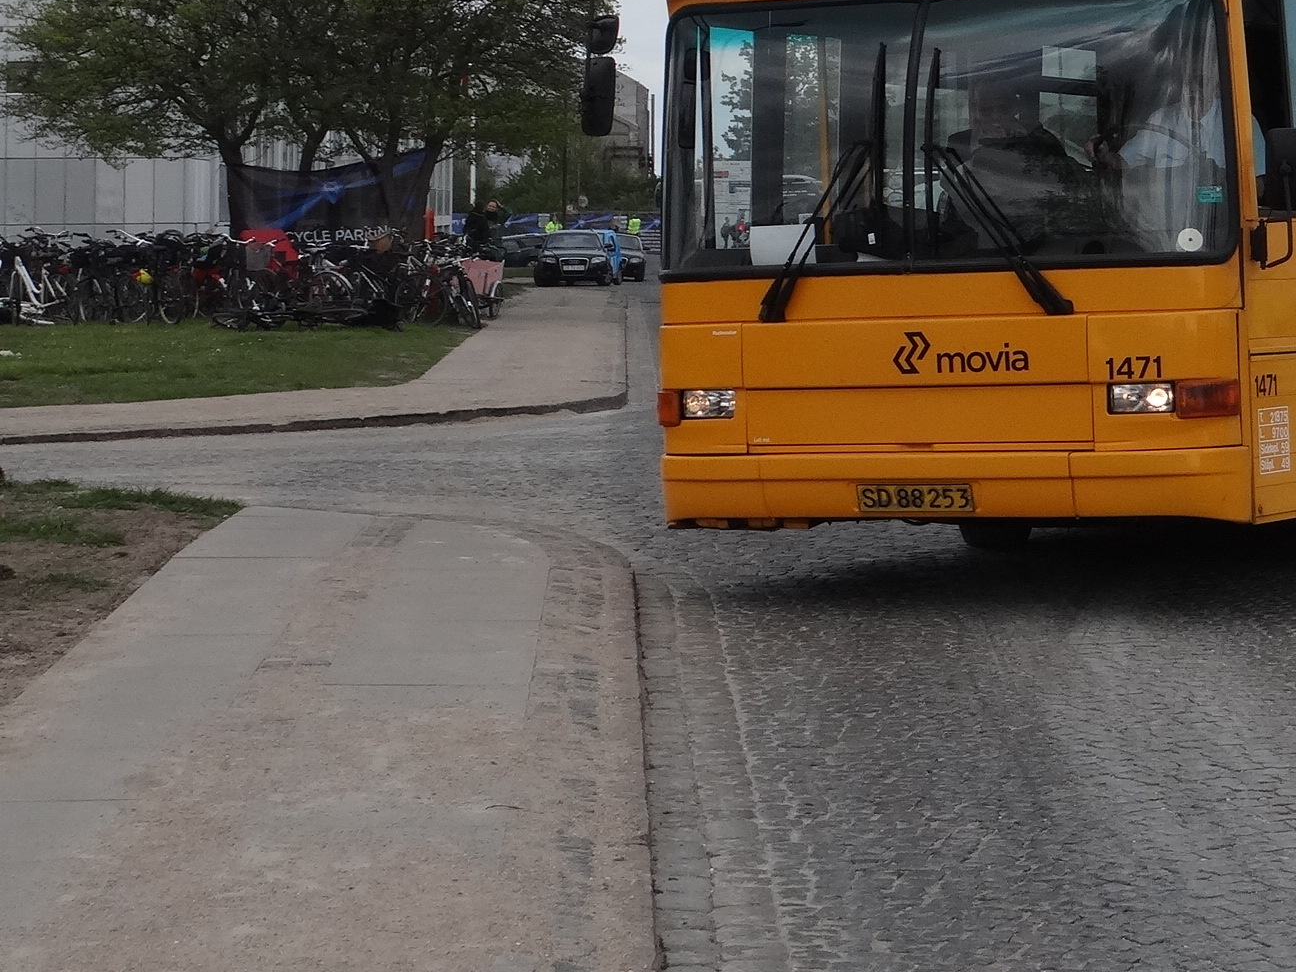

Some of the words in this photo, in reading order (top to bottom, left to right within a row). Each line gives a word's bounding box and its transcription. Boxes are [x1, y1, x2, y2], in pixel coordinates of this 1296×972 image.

[936, 342, 1029, 374] movia
[1105, 355, 1162, 380] 1471
[1254, 374, 1278, 398] 1471
[862, 488, 891, 508] SD
[896, 488, 924, 508] 88
[926, 488, 970, 508] 253
